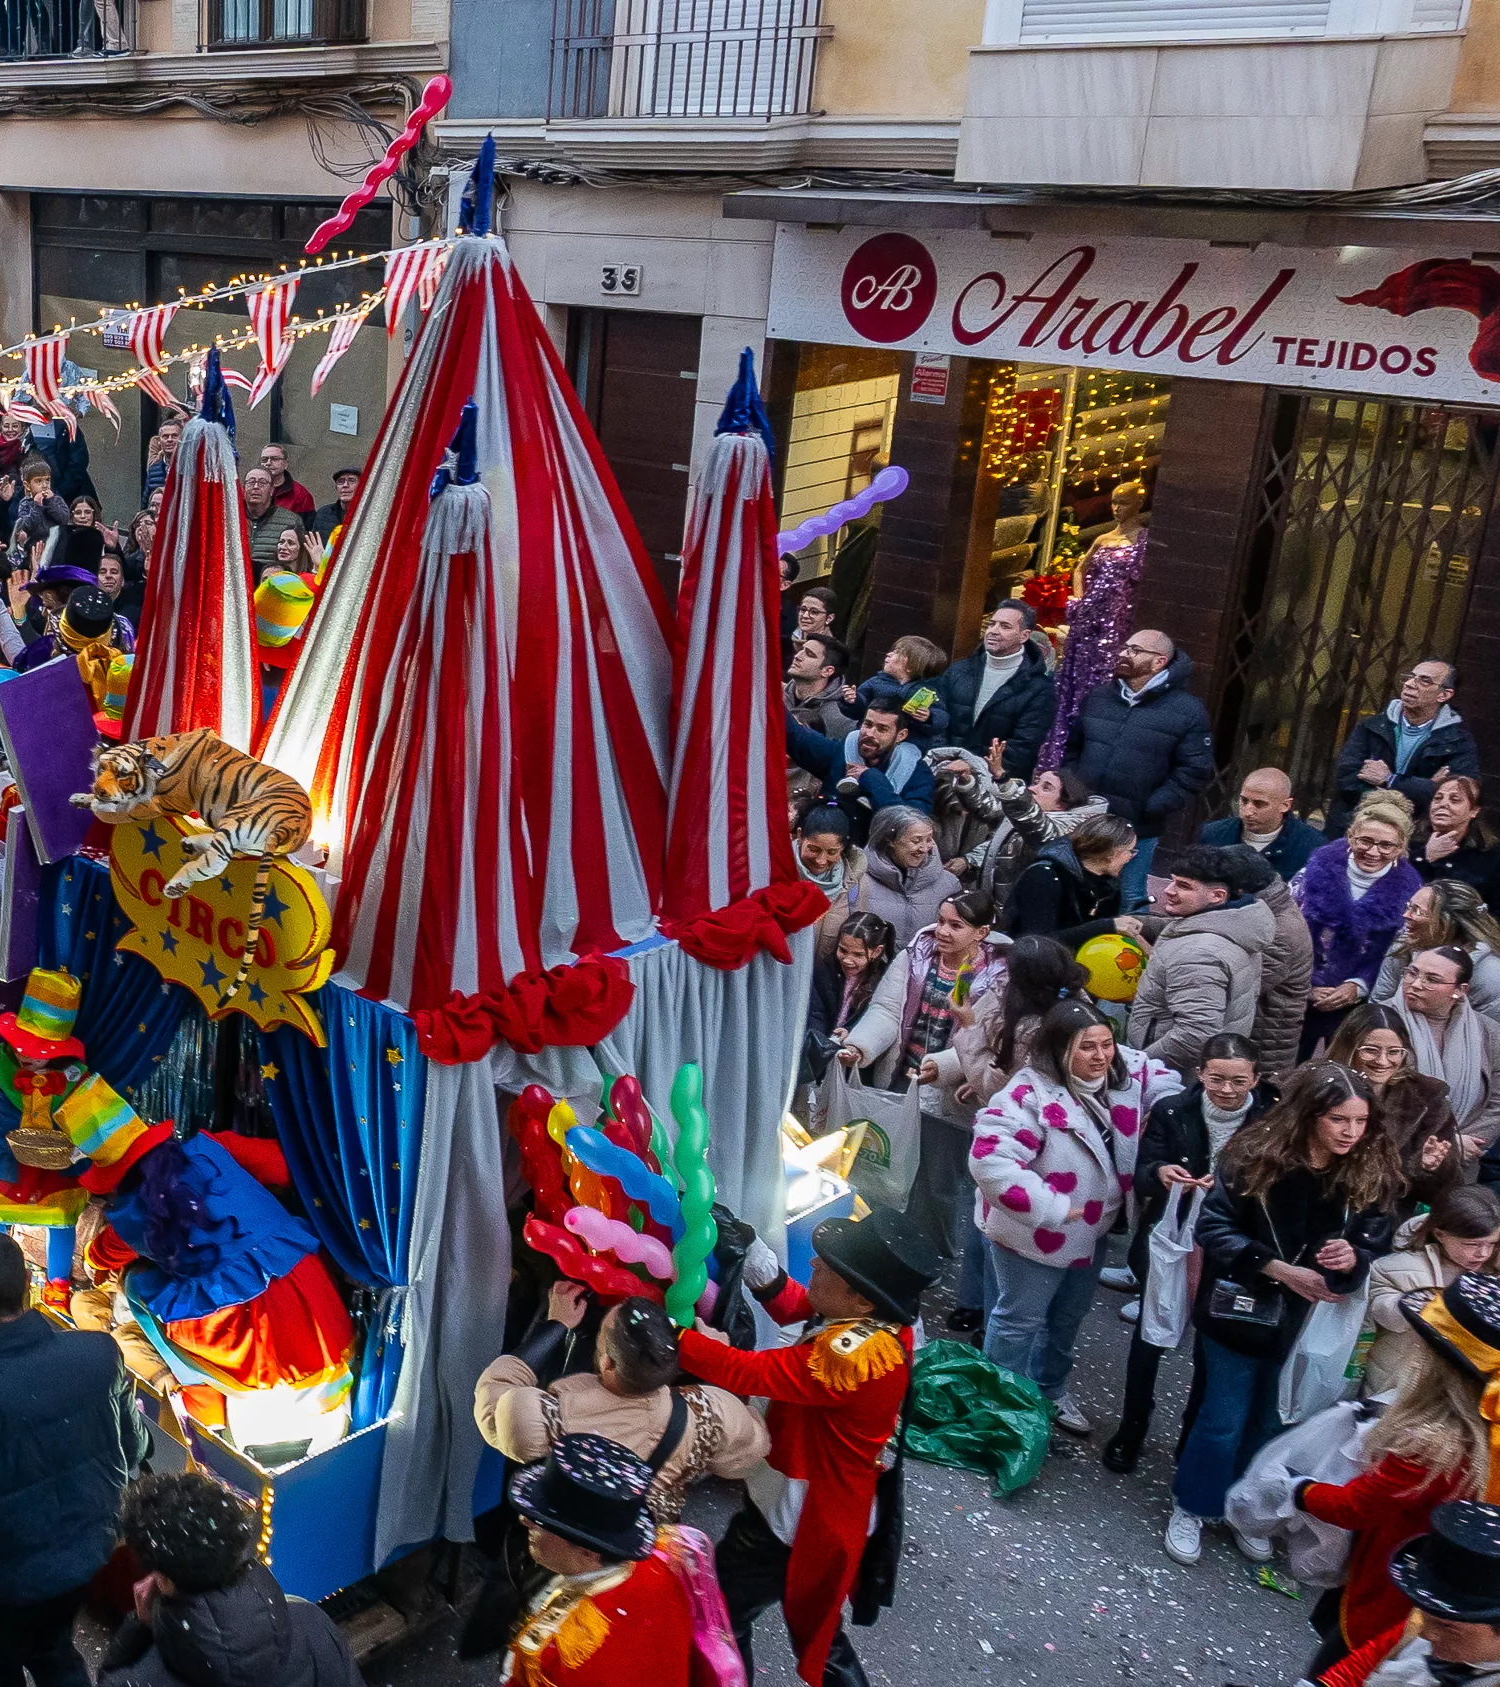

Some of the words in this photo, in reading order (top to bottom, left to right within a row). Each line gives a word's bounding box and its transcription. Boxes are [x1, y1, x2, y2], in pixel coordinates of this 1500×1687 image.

[601, 267, 638, 292] 35
[851, 264, 922, 311] AB
[952, 246, 1296, 366] Arabel
[1272, 336, 1439, 378] TEJIDOS
[139, 868, 277, 968] CIRCO
